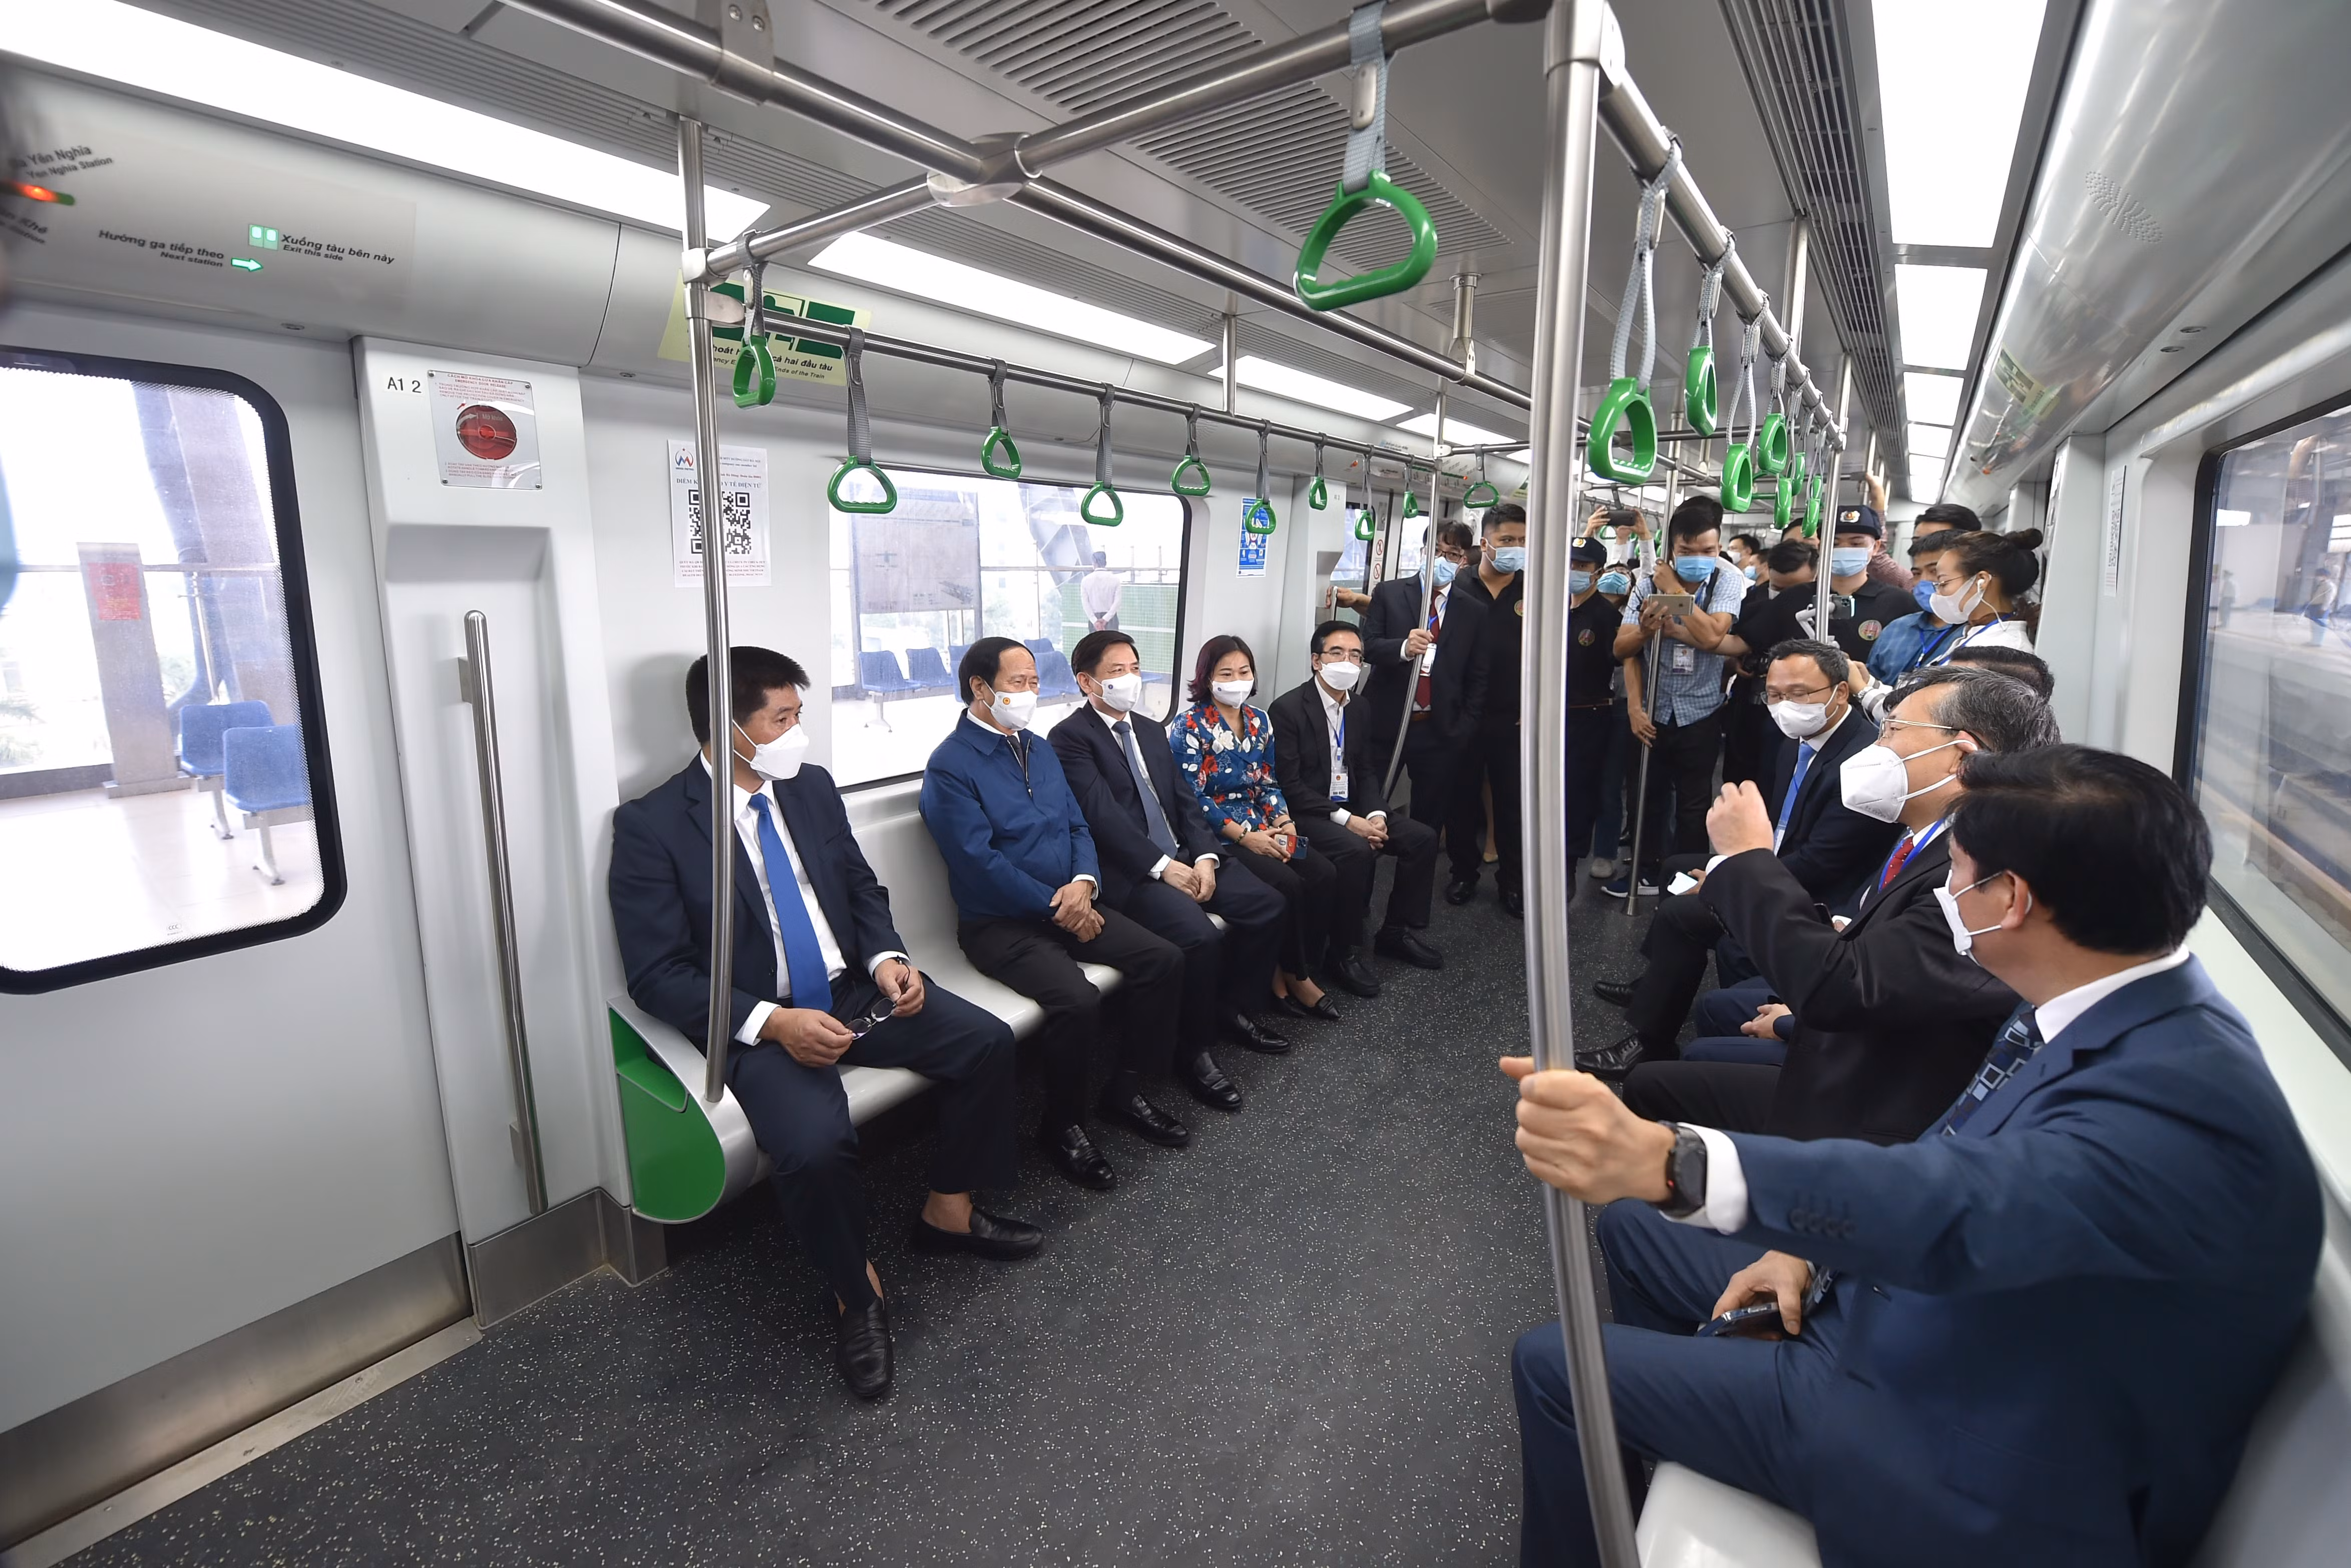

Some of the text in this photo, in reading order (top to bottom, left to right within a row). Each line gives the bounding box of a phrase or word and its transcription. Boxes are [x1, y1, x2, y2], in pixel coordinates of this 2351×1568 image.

[78, 157, 113, 169] Station
[99, 230, 224, 259] Hướng ga tiếp theo
[281, 234, 322, 251] Xuống
[326, 244, 345, 253] tàu
[348, 248, 370, 259] bên
[283, 244, 343, 261] Exit this side
[160, 252, 223, 267] Next station
[784, 357, 799, 365] hai
[801, 359, 817, 368] đầu
[819, 363, 833, 371] tàu
[387, 376, 422, 394] A1 2
